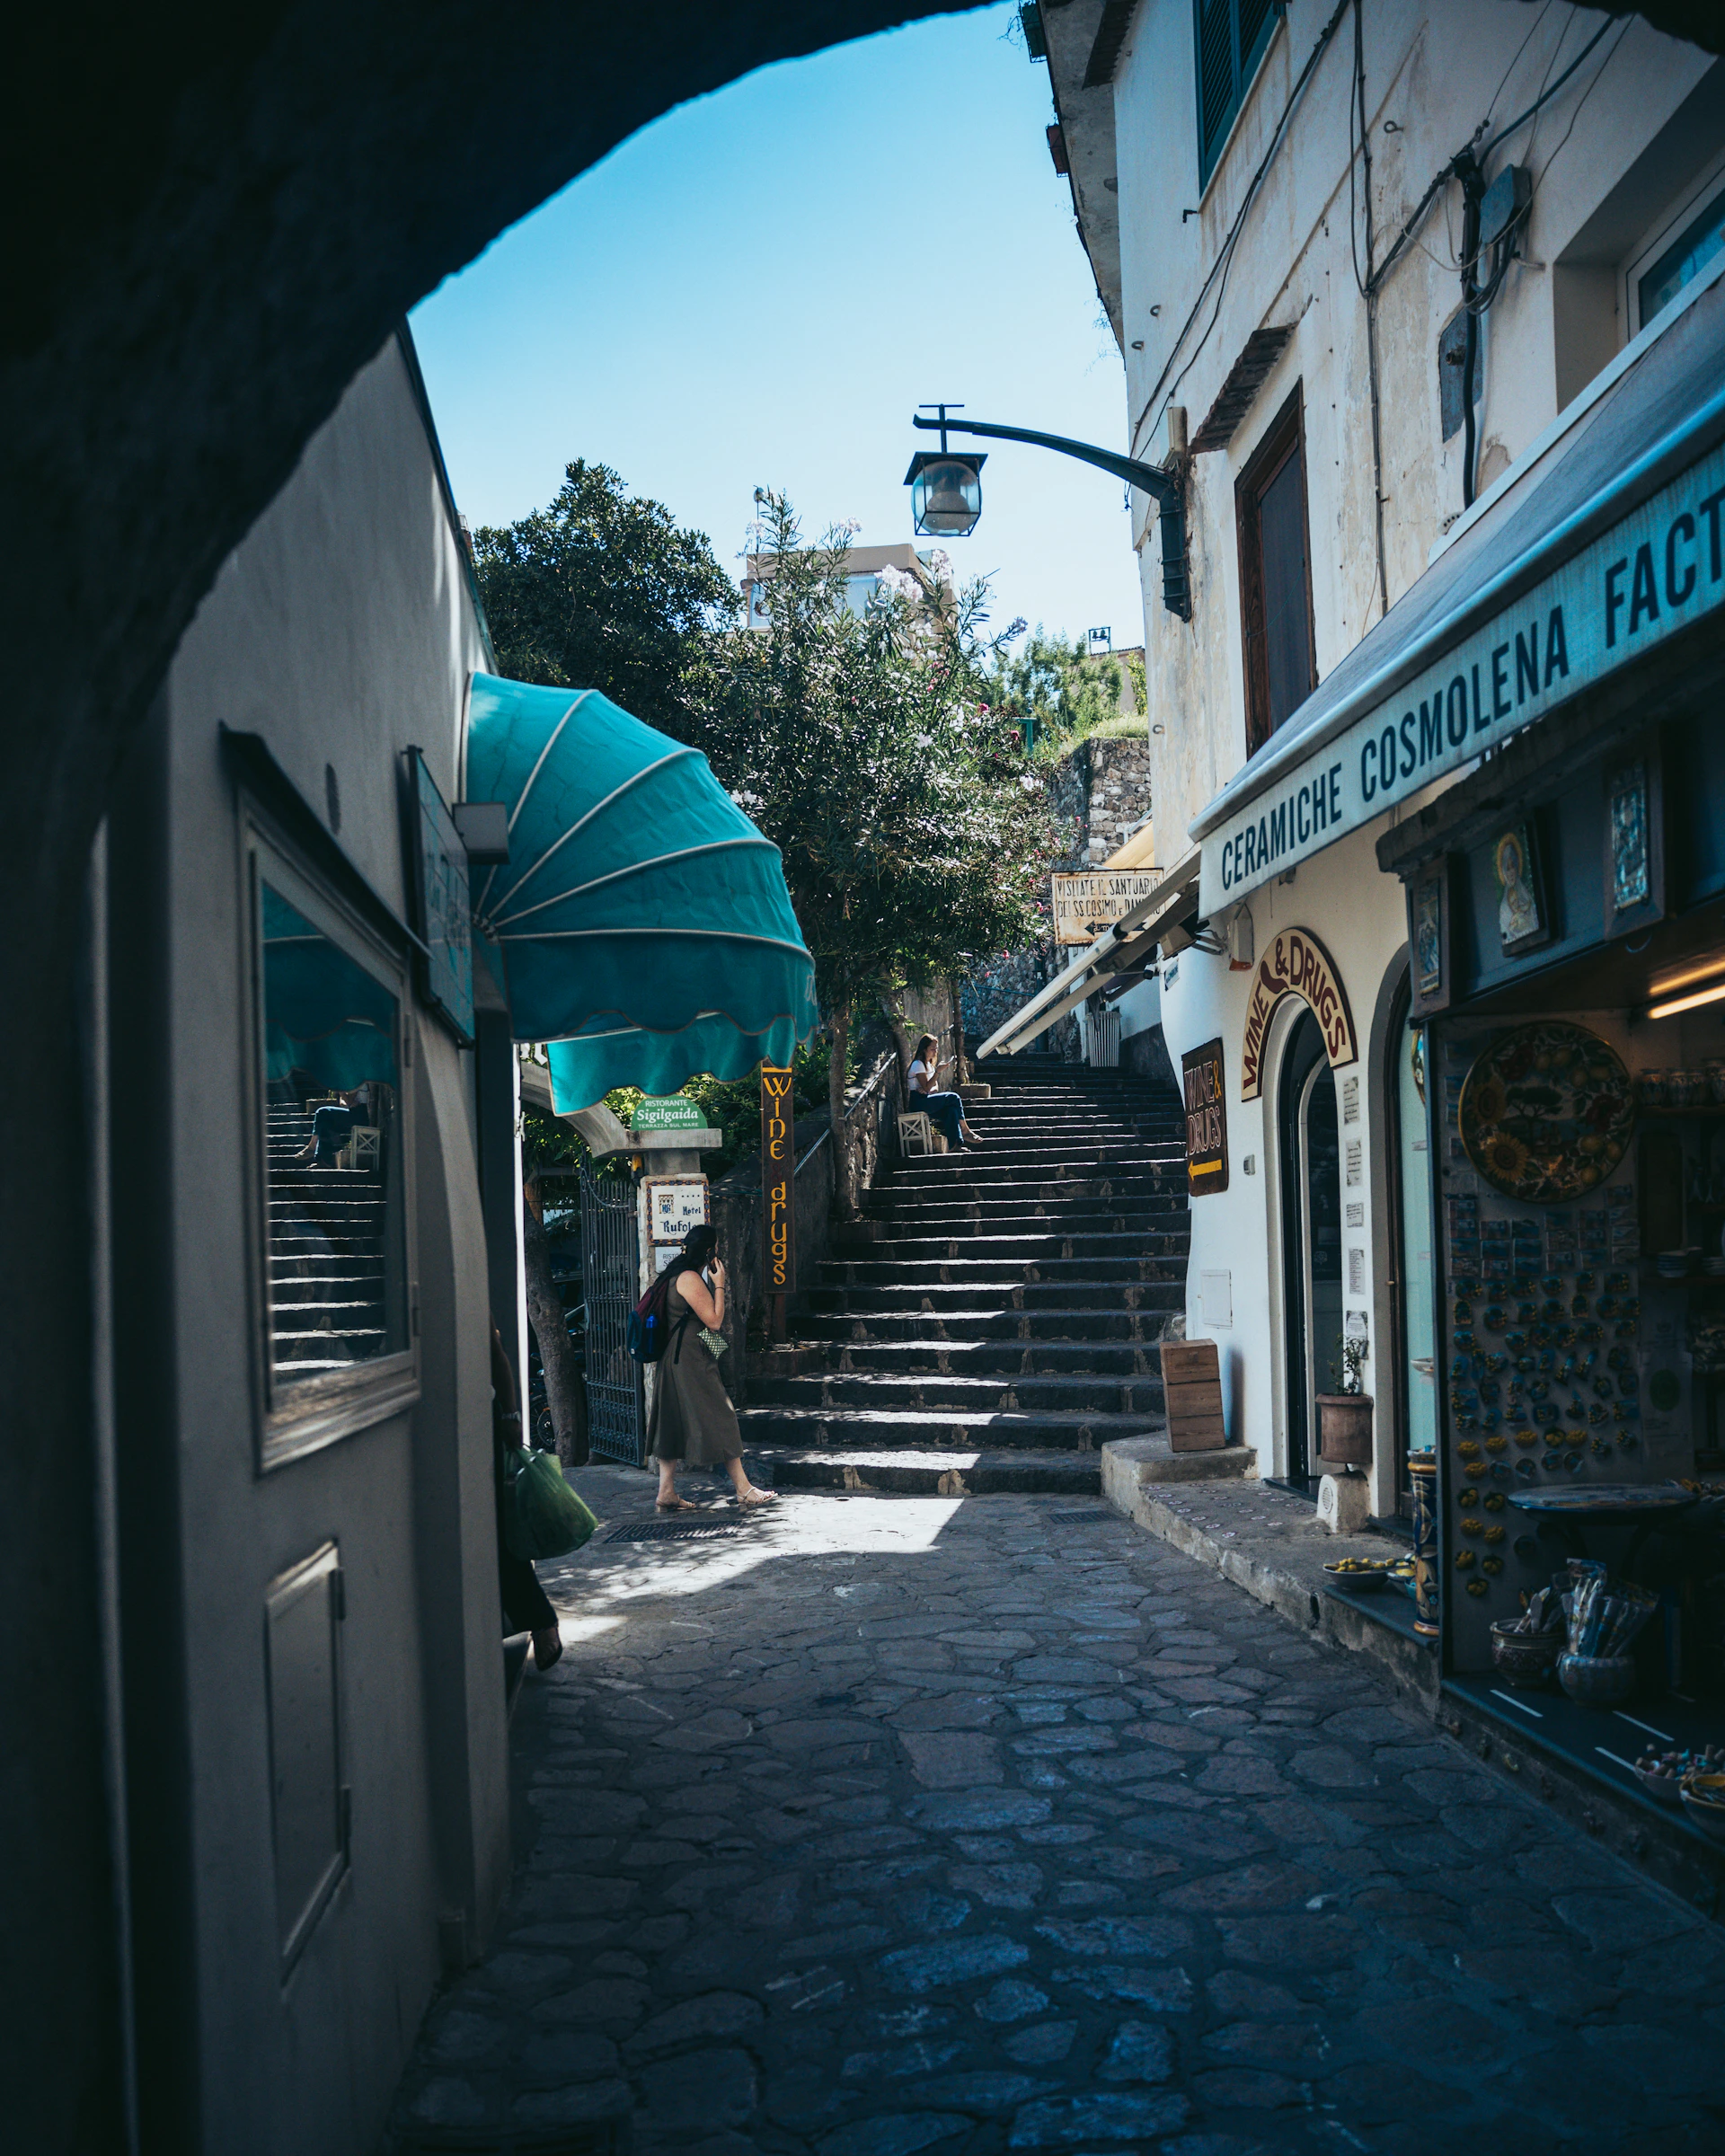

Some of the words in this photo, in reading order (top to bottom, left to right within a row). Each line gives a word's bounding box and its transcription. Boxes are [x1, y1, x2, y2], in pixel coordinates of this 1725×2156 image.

[1222, 762, 1342, 891] CERAMICHE
[1360, 605, 1569, 802] COSMOLENA
[1098, 879, 1107, 896] IL
[1110, 877, 1159, 896] SANTUARIO
[1243, 980, 1270, 1090] WINE
[1275, 937, 1289, 976] &
[1290, 935, 1346, 1058] DRUGS
[645, 1100, 688, 1108] RISTORANTE
[1183, 1062, 1214, 1111] WINE
[1214, 1059, 1223, 1100] &
[637, 1108, 699, 1123] Sigilgaida
[1187, 1106, 1222, 1157] DRUGS
[683, 1206, 701, 1216] Hotel
[770, 1180, 787, 1286] drugs
